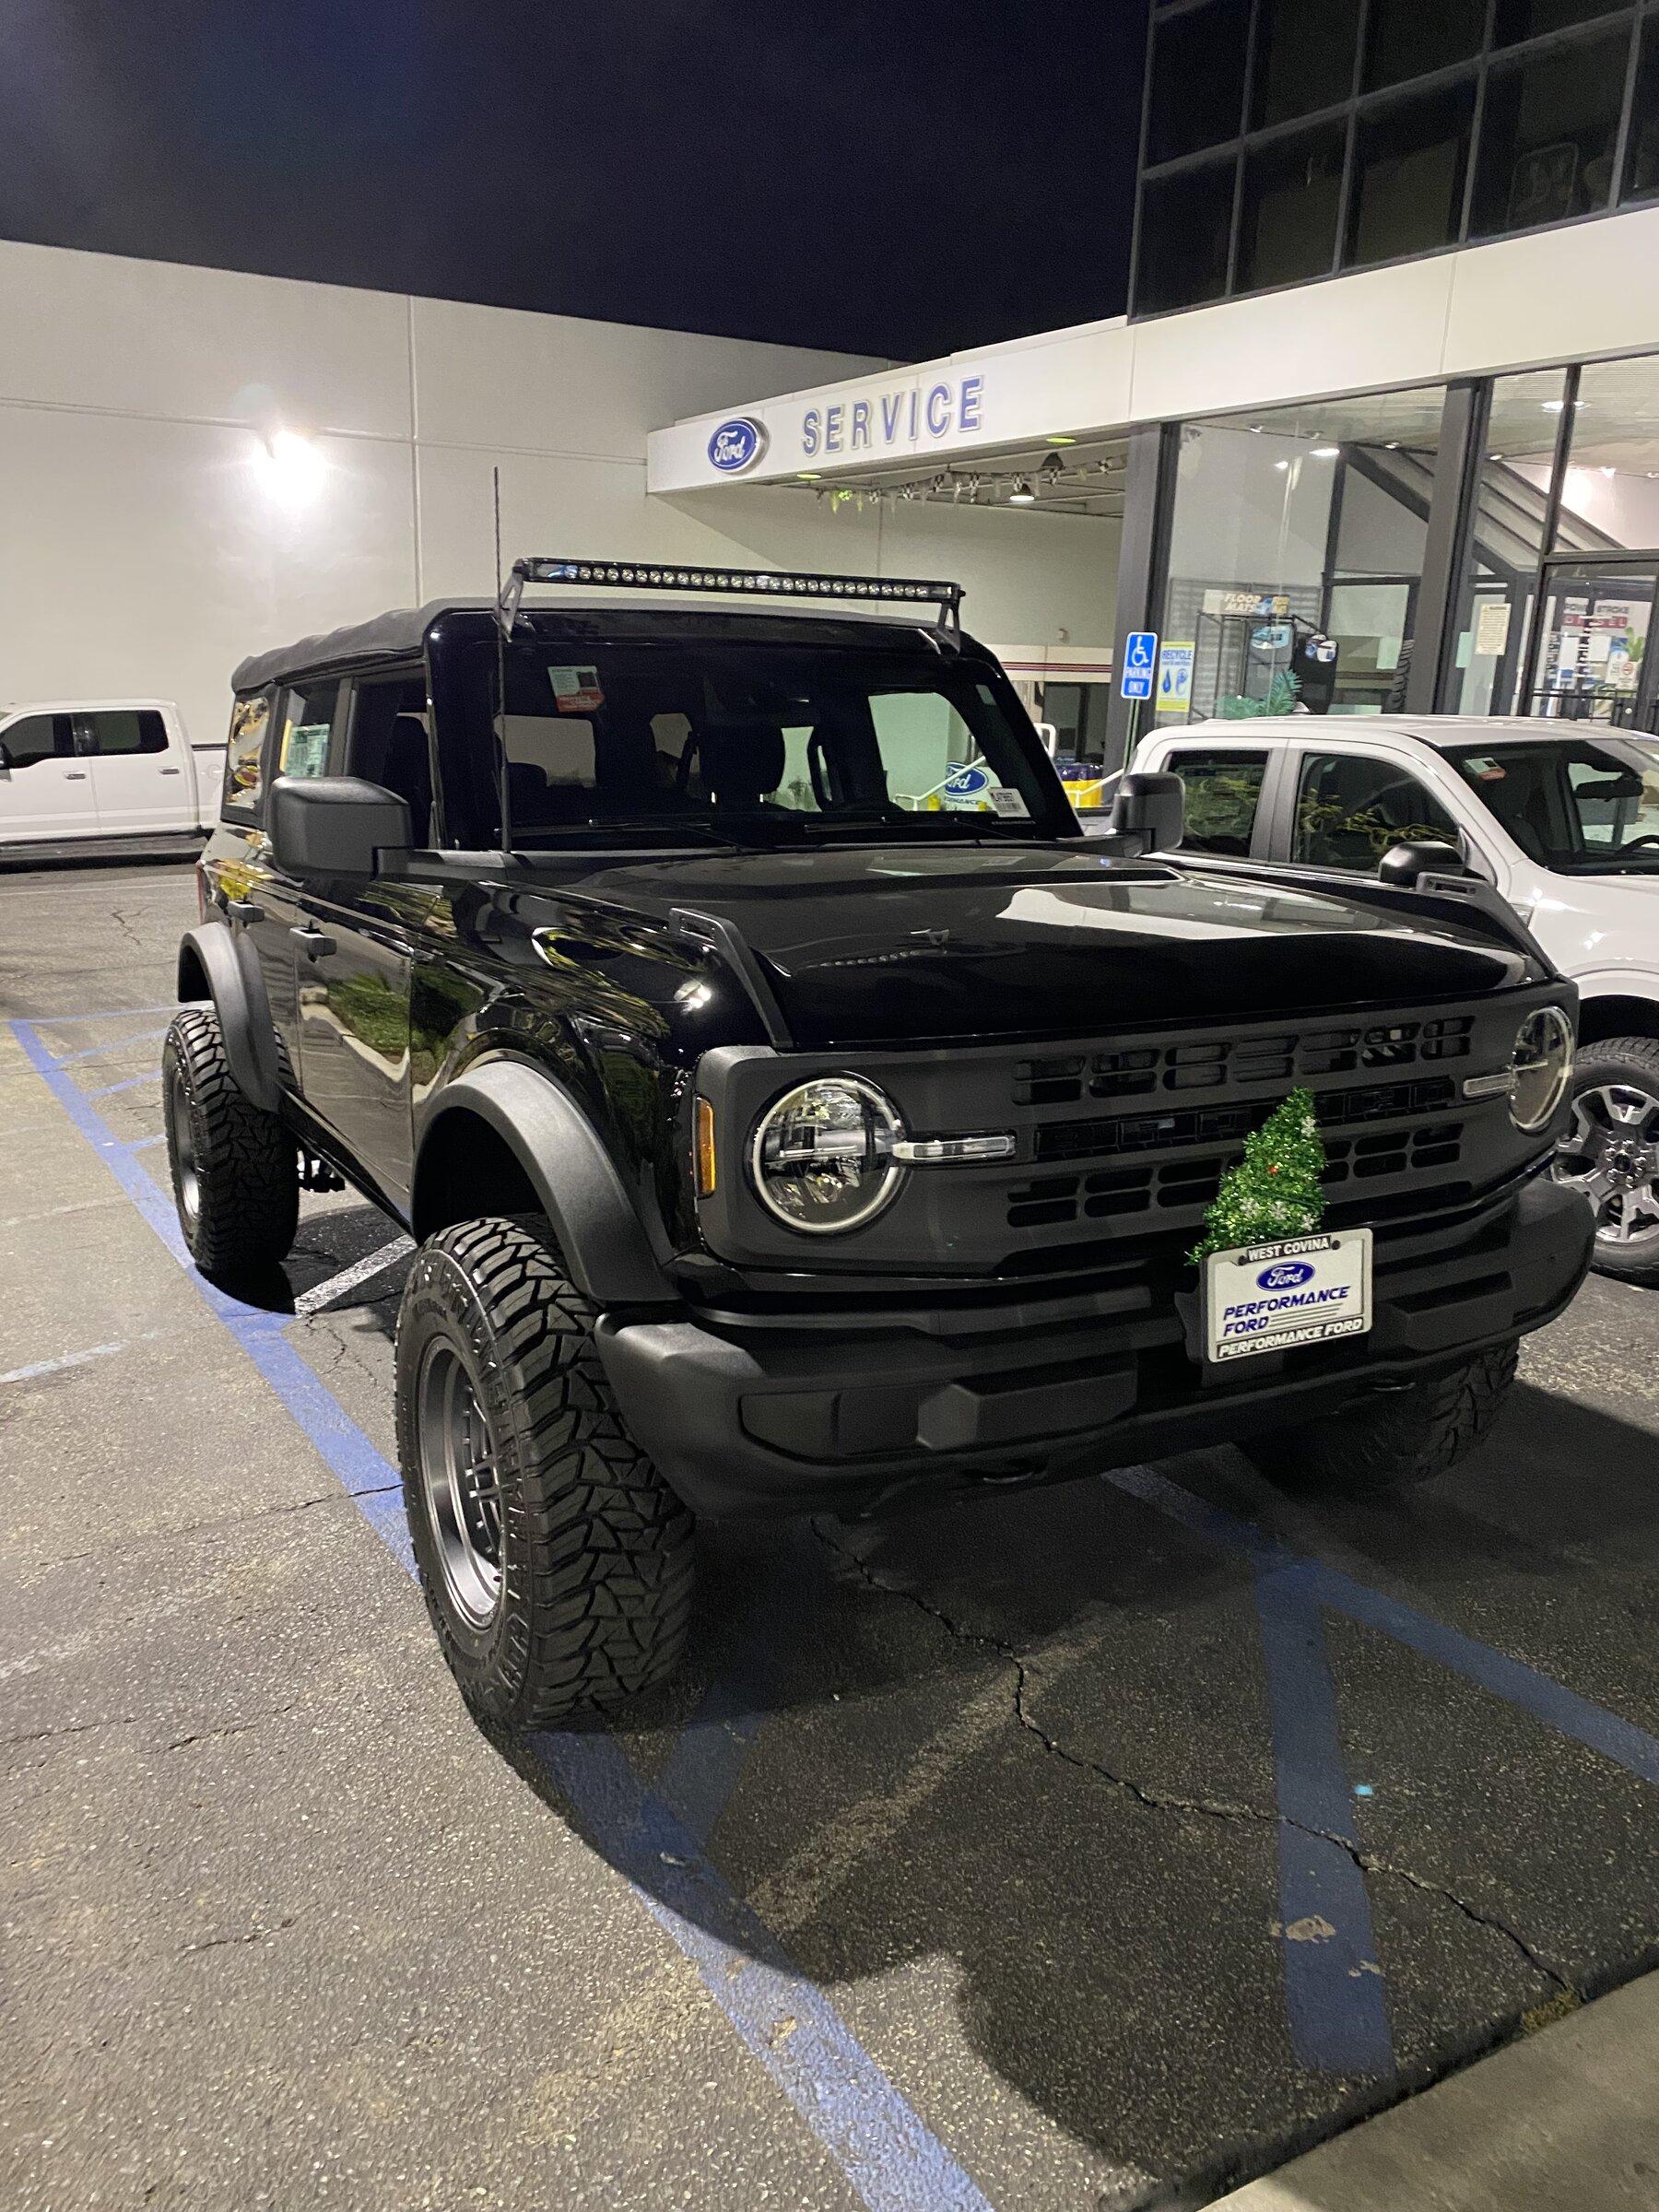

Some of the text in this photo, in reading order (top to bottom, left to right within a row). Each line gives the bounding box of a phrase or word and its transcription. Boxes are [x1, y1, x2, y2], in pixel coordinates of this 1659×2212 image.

[801, 375, 982, 456] SERVICE
[713, 430, 746, 462] Ford
[1224, 593, 1261, 604] FLOOR
[1246, 1238, 1330, 1261] WEST COVINA
[1267, 1266, 1304, 1288] Ford
[1223, 1286, 1351, 1321] PERFORMANCE
[1218, 1318, 1363, 1358] PERFORMANCE FORD
[1223, 1315, 1270, 1336] FORD
